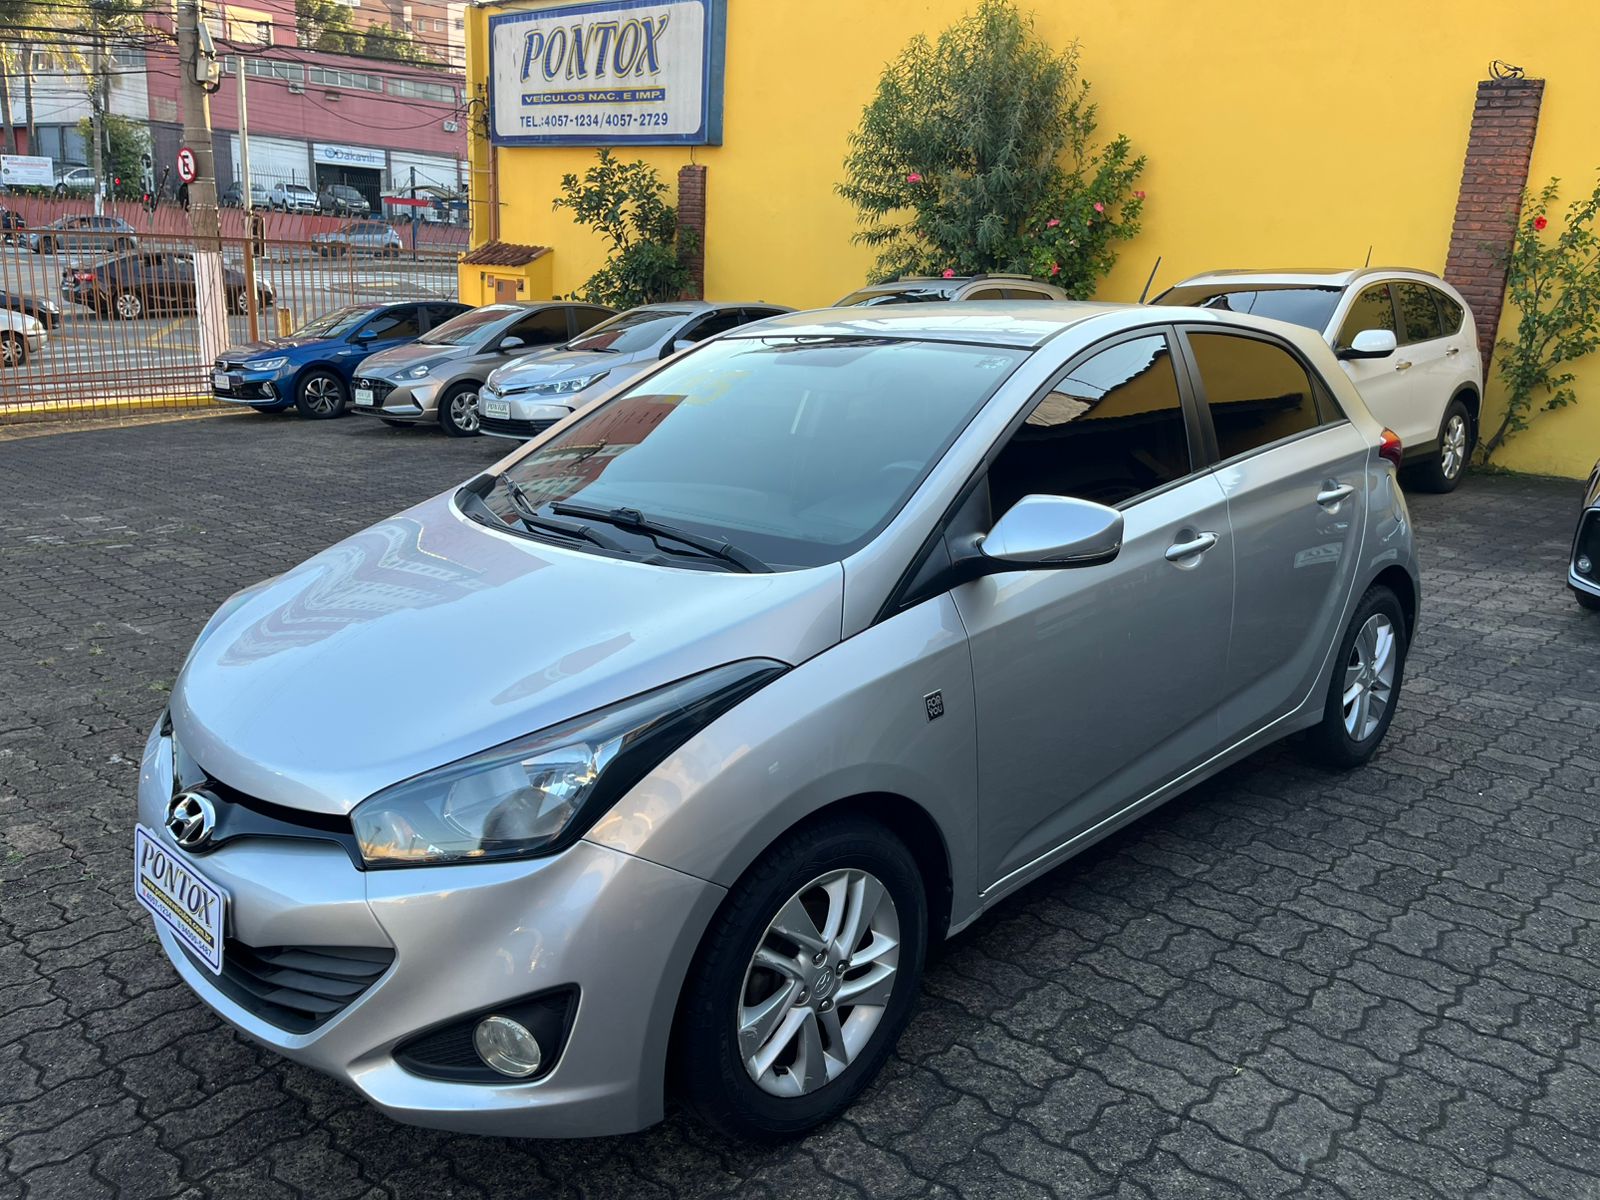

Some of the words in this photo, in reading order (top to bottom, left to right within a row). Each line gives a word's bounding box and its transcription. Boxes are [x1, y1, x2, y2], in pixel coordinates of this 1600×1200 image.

[520, 14, 669, 83] PONTOX
[589, 92, 619, 101] NAC.
[624, 91, 631, 100] E
[636, 90, 662, 99] IMP.
[141, 840, 215, 928] PONTOX
